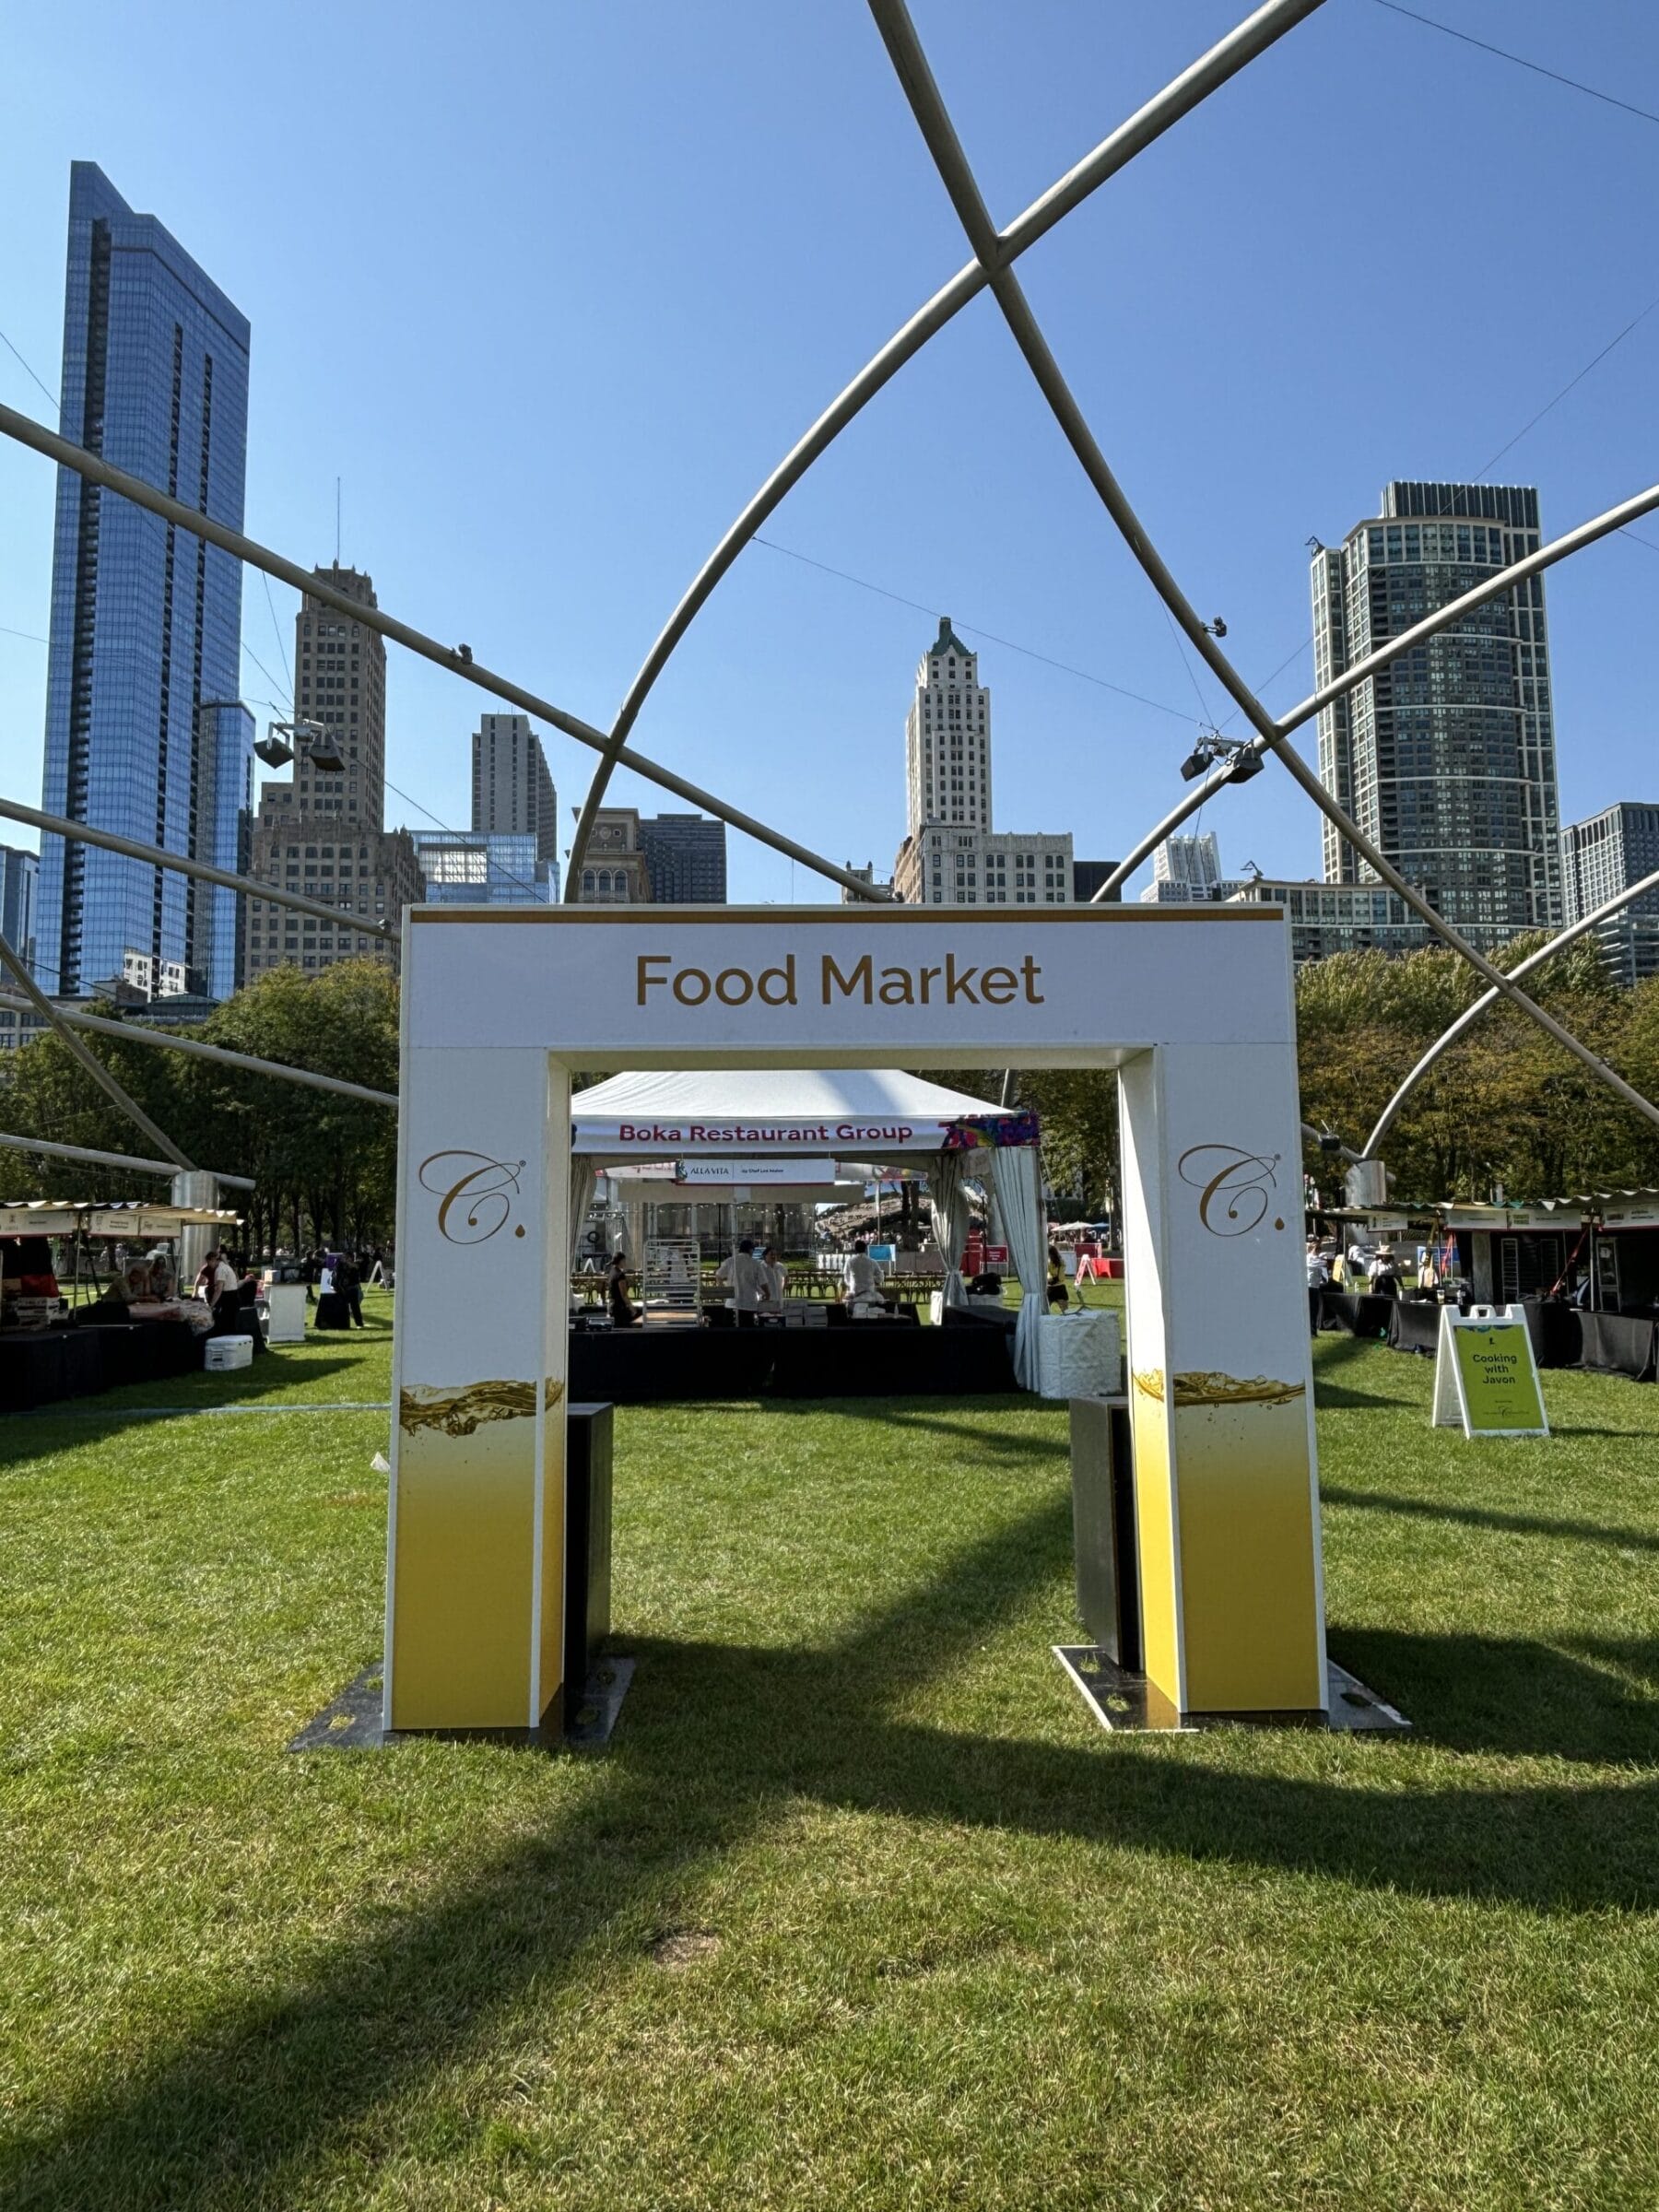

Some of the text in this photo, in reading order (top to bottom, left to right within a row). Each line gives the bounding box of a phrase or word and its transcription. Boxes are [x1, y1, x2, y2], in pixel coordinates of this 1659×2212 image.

[638, 954, 1044, 1006] Food Market
[619, 1124, 913, 1143] Boka Restaurant Group
[1473, 1354, 1517, 1364] Cooking
[1484, 1365, 1509, 1373] with
[1482, 1375, 1515, 1384] Javon
